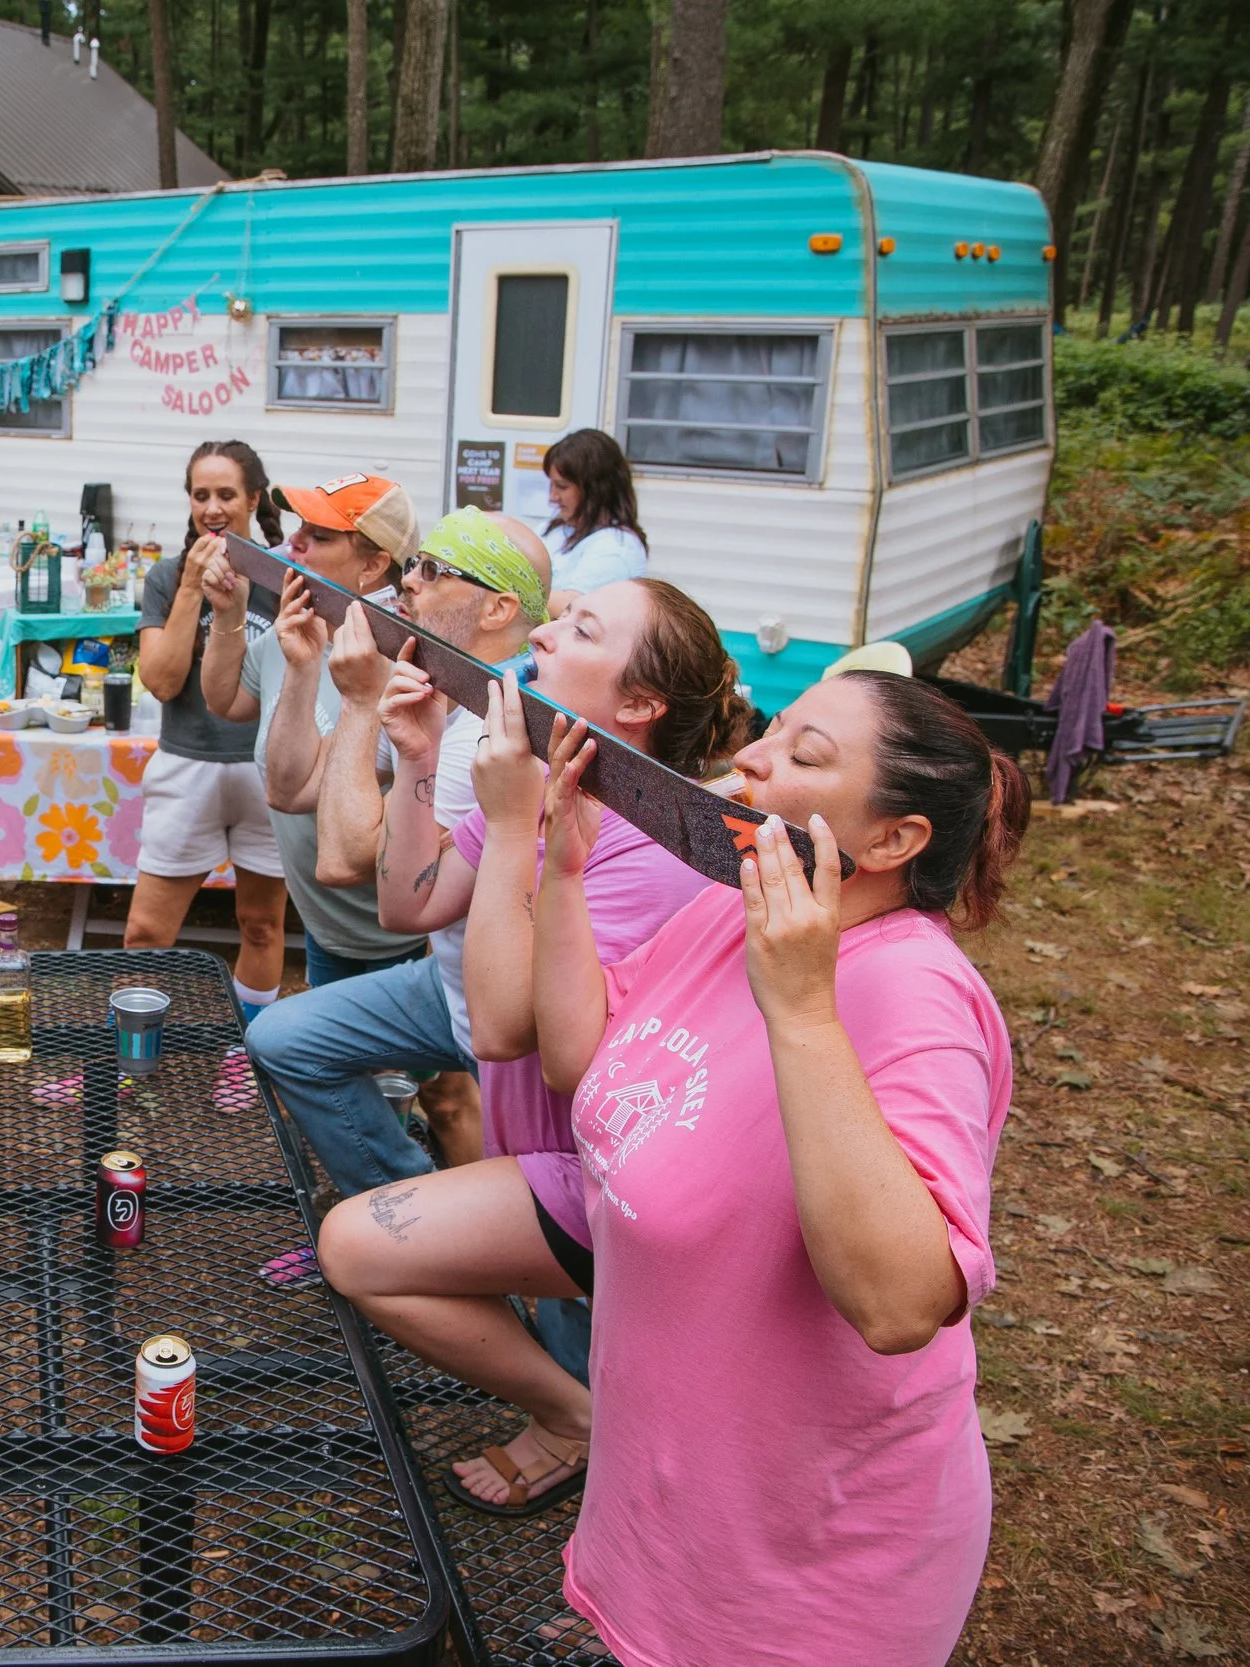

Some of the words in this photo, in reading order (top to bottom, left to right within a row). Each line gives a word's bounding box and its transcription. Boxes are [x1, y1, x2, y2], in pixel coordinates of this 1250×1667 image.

[123, 295, 201, 339] HAPPY
[130, 339, 218, 376] CAMPER
[162, 367, 251, 415] SALOON
[467, 459, 492, 467] CAMP
[488, 450, 500, 460] TO
[480, 467, 501, 476] YEAR
[620, 1200, 638, 1220] Ups
